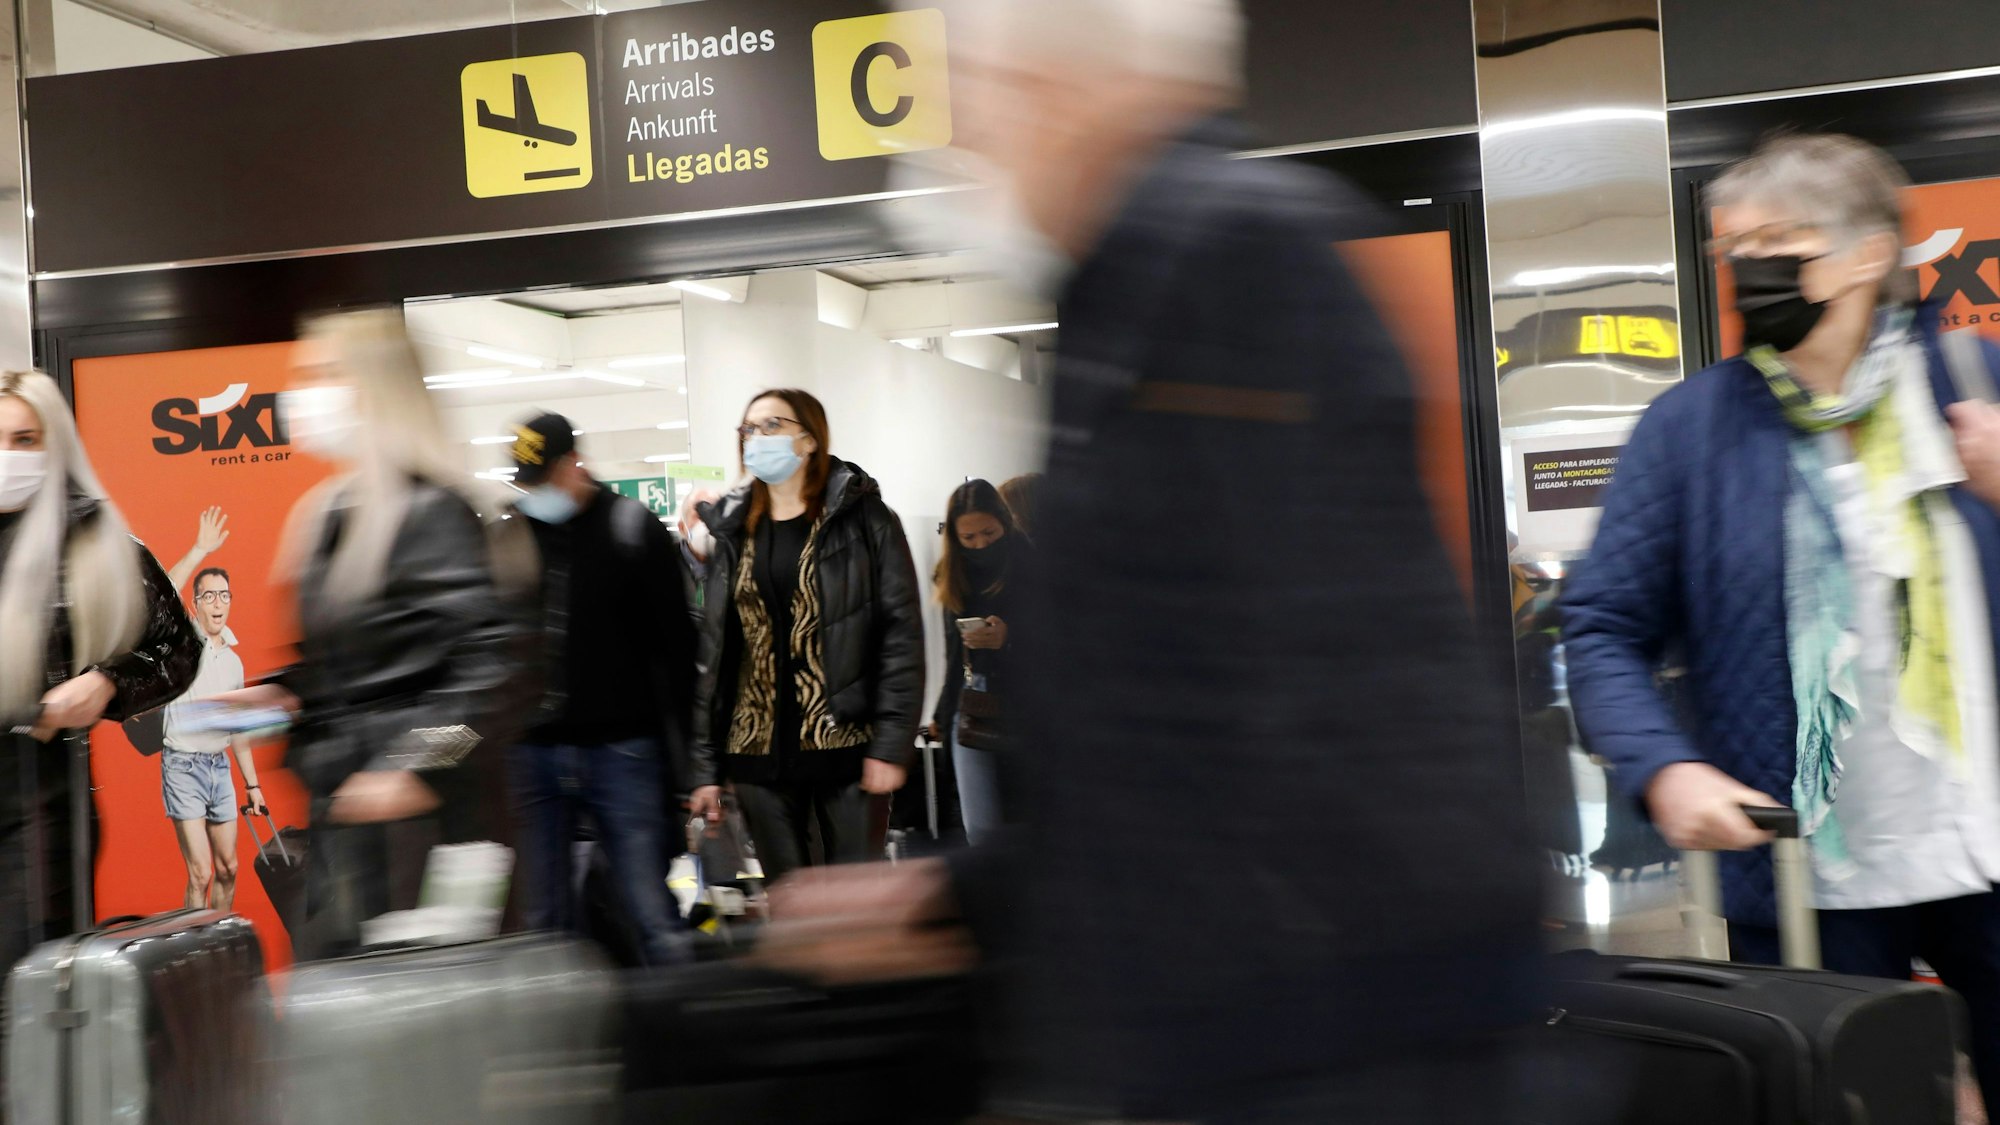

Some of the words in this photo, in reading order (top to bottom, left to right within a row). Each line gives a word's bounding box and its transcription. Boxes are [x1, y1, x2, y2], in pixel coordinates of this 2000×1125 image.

[622, 25, 776, 69] Arribades
[624, 72, 715, 105] Arrivals
[850, 41, 915, 128] C
[626, 109, 718, 142] Ankunft
[627, 143, 769, 184] Llegadas
[211, 453, 246, 466] rent
[251, 455, 260, 463] a
[264, 451, 291, 462] car
[1533, 462, 1558, 471] ACCESO
[1559, 460, 1578, 468] PARA
[1579, 457, 1619, 467] EMPLEADOS
[1534, 472, 1556, 480] JUNTO
[1563, 467, 1616, 478] MONTACARGAS
[1534, 481, 1568, 490] LLEGADAS
